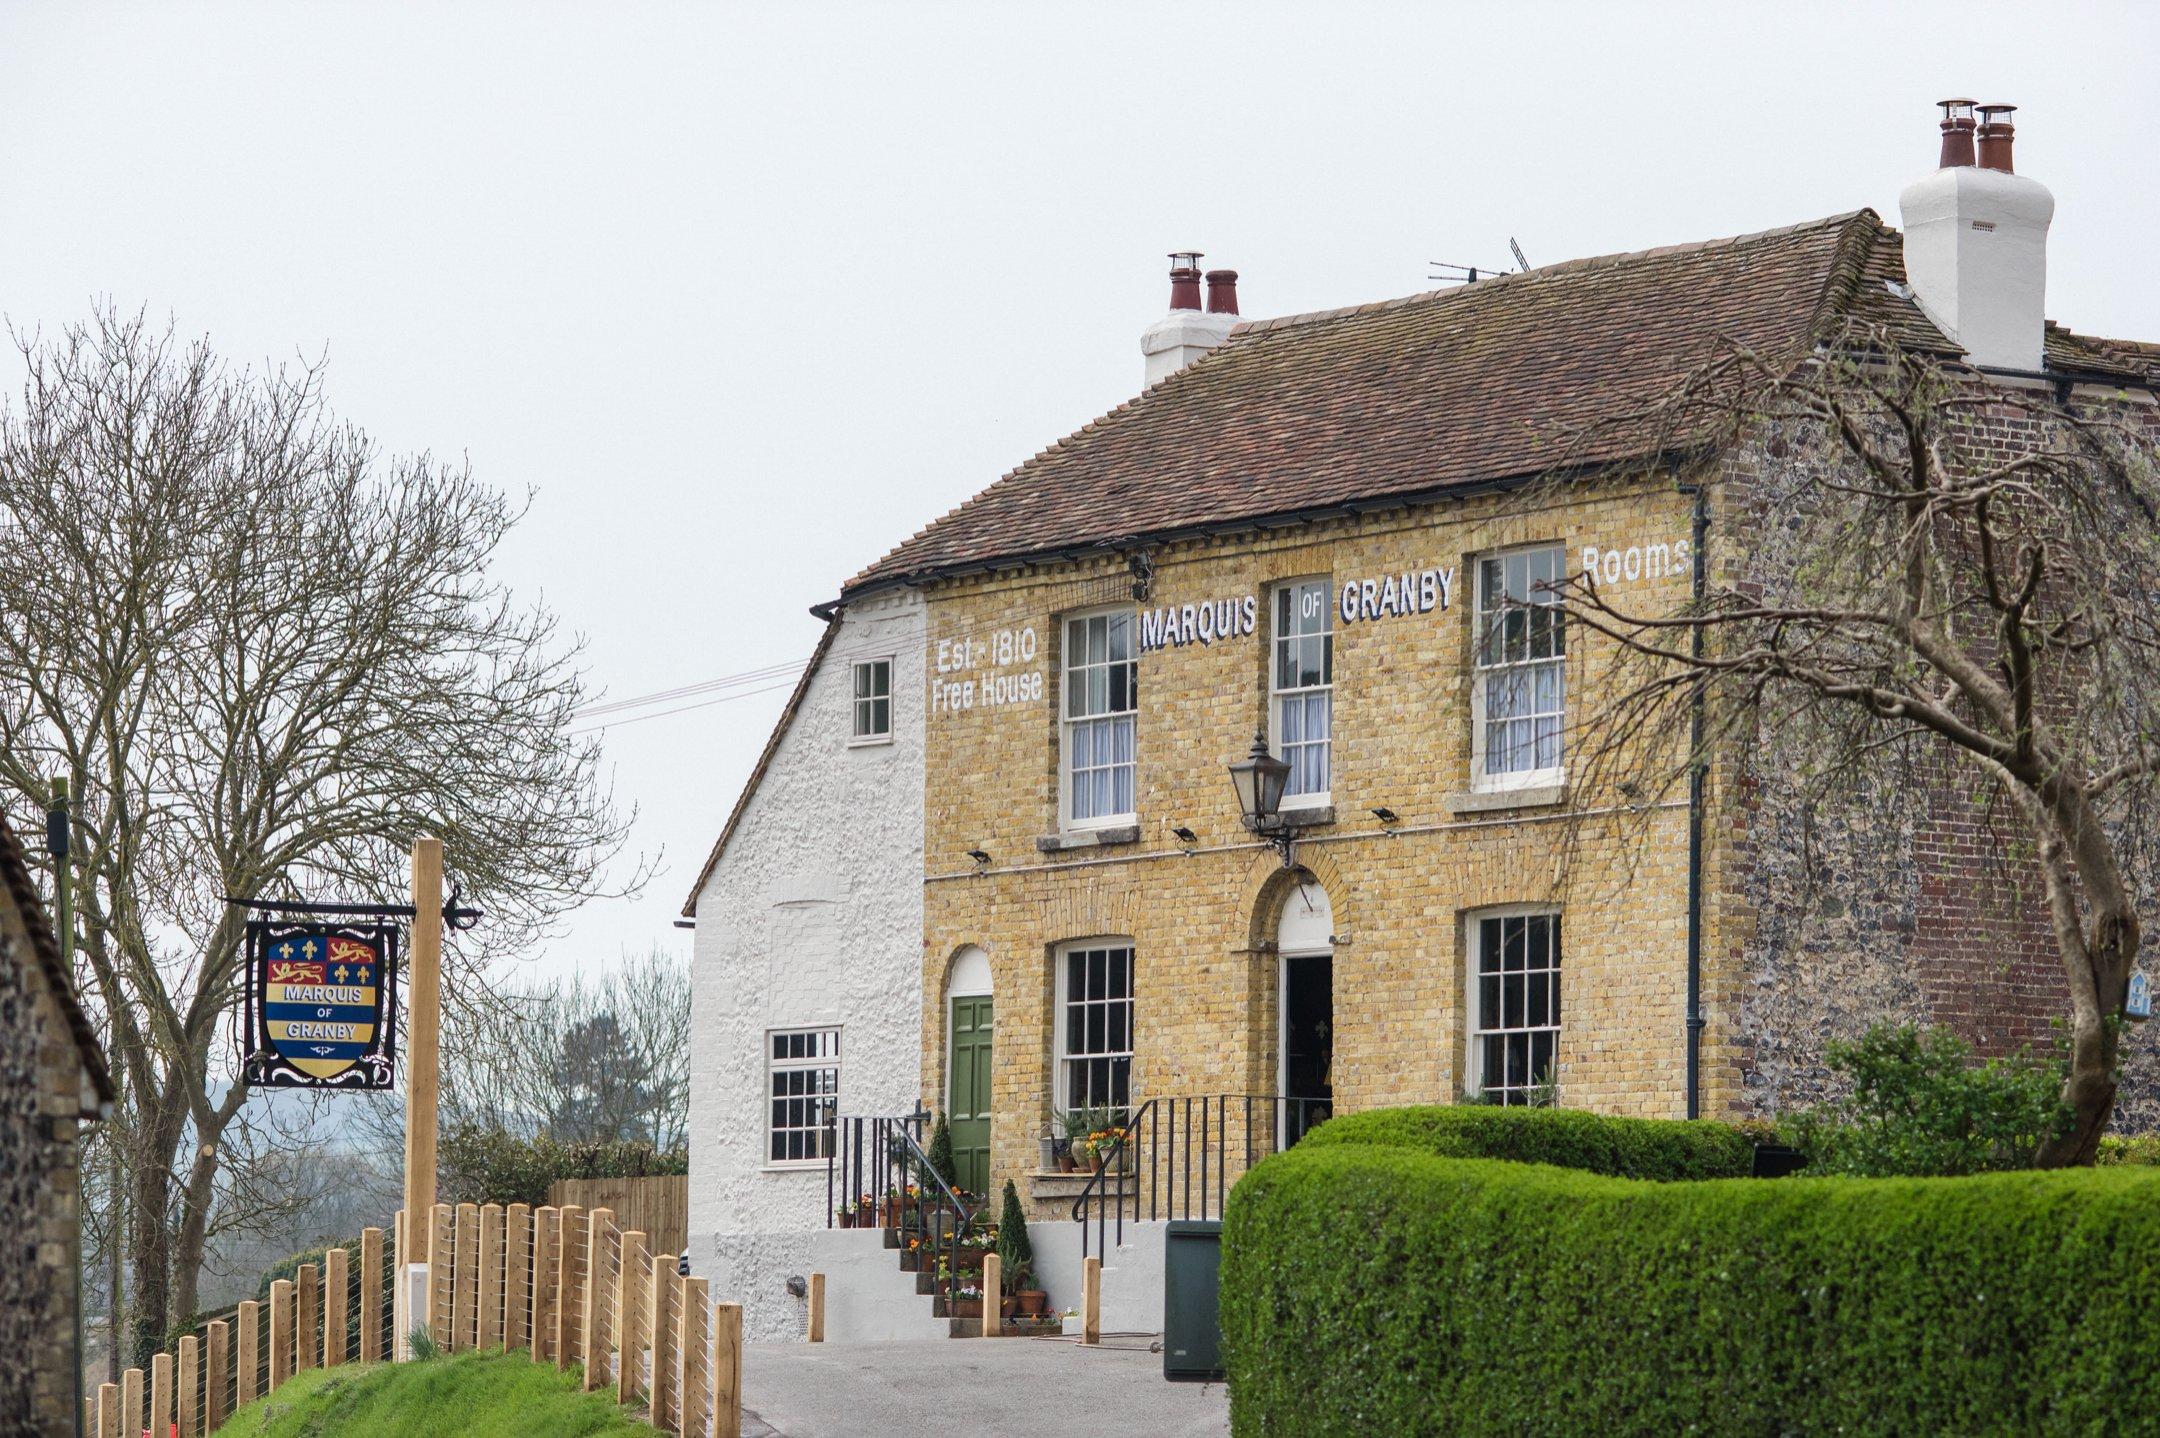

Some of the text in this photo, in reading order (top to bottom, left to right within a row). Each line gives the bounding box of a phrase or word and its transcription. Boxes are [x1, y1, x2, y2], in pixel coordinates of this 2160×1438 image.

[1583, 539, 1690, 587] Rooms
[1141, 567, 1455, 653] MARQUIS OF GRANBY
[992, 627, 1036, 665] 1810
[932, 671, 1043, 714] Free House
[284, 985, 362, 1003] MARQUIS
[317, 1007, 333, 1018] OF
[286, 1022, 357, 1040] GRANBY
